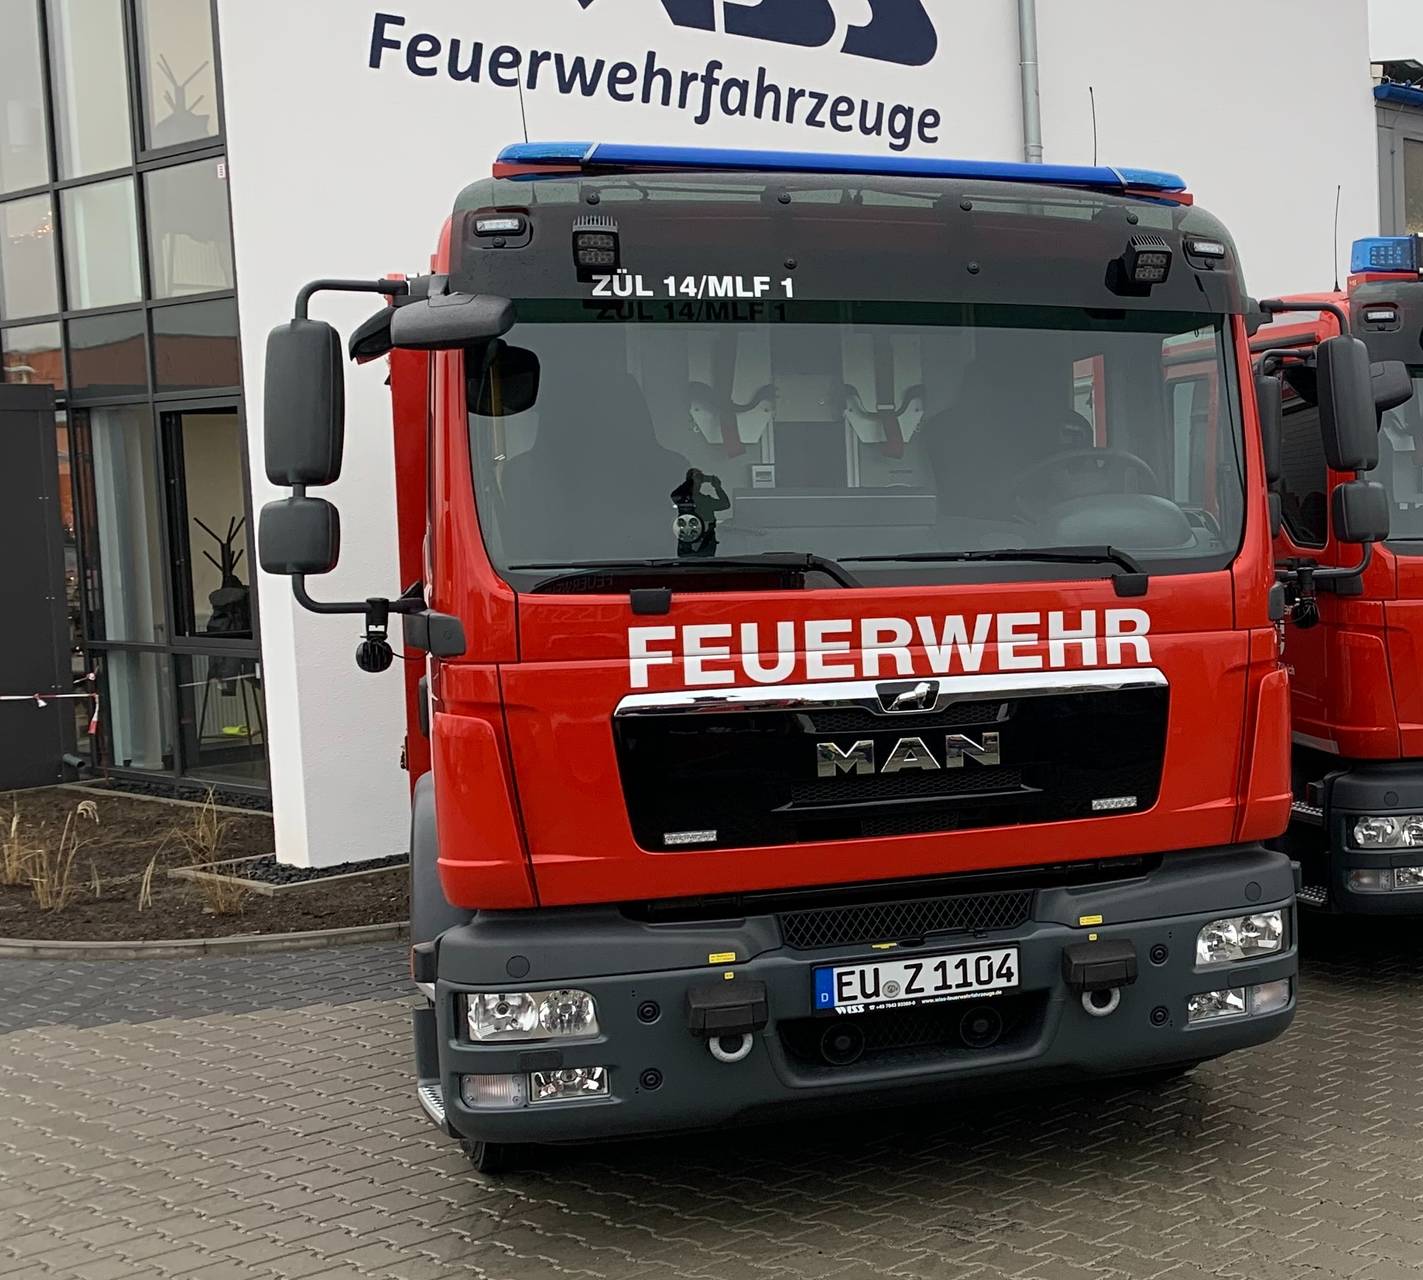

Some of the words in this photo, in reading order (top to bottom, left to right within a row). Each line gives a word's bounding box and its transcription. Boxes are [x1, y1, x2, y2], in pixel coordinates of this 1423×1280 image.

[368, 12, 941, 151] Feuerwehrfahrzeuge
[592, 268, 653, 297] ZÜL
[664, 275, 770, 299] 14/MLF
[781, 278, 793, 298] 1
[628, 608, 1153, 688] FEUERWEHR
[816, 731, 1000, 777] MAN
[821, 992, 829, 1002] D
[836, 968, 880, 1003] EU
[903, 963, 925, 995] Z
[933, 952, 1015, 992] 1104
